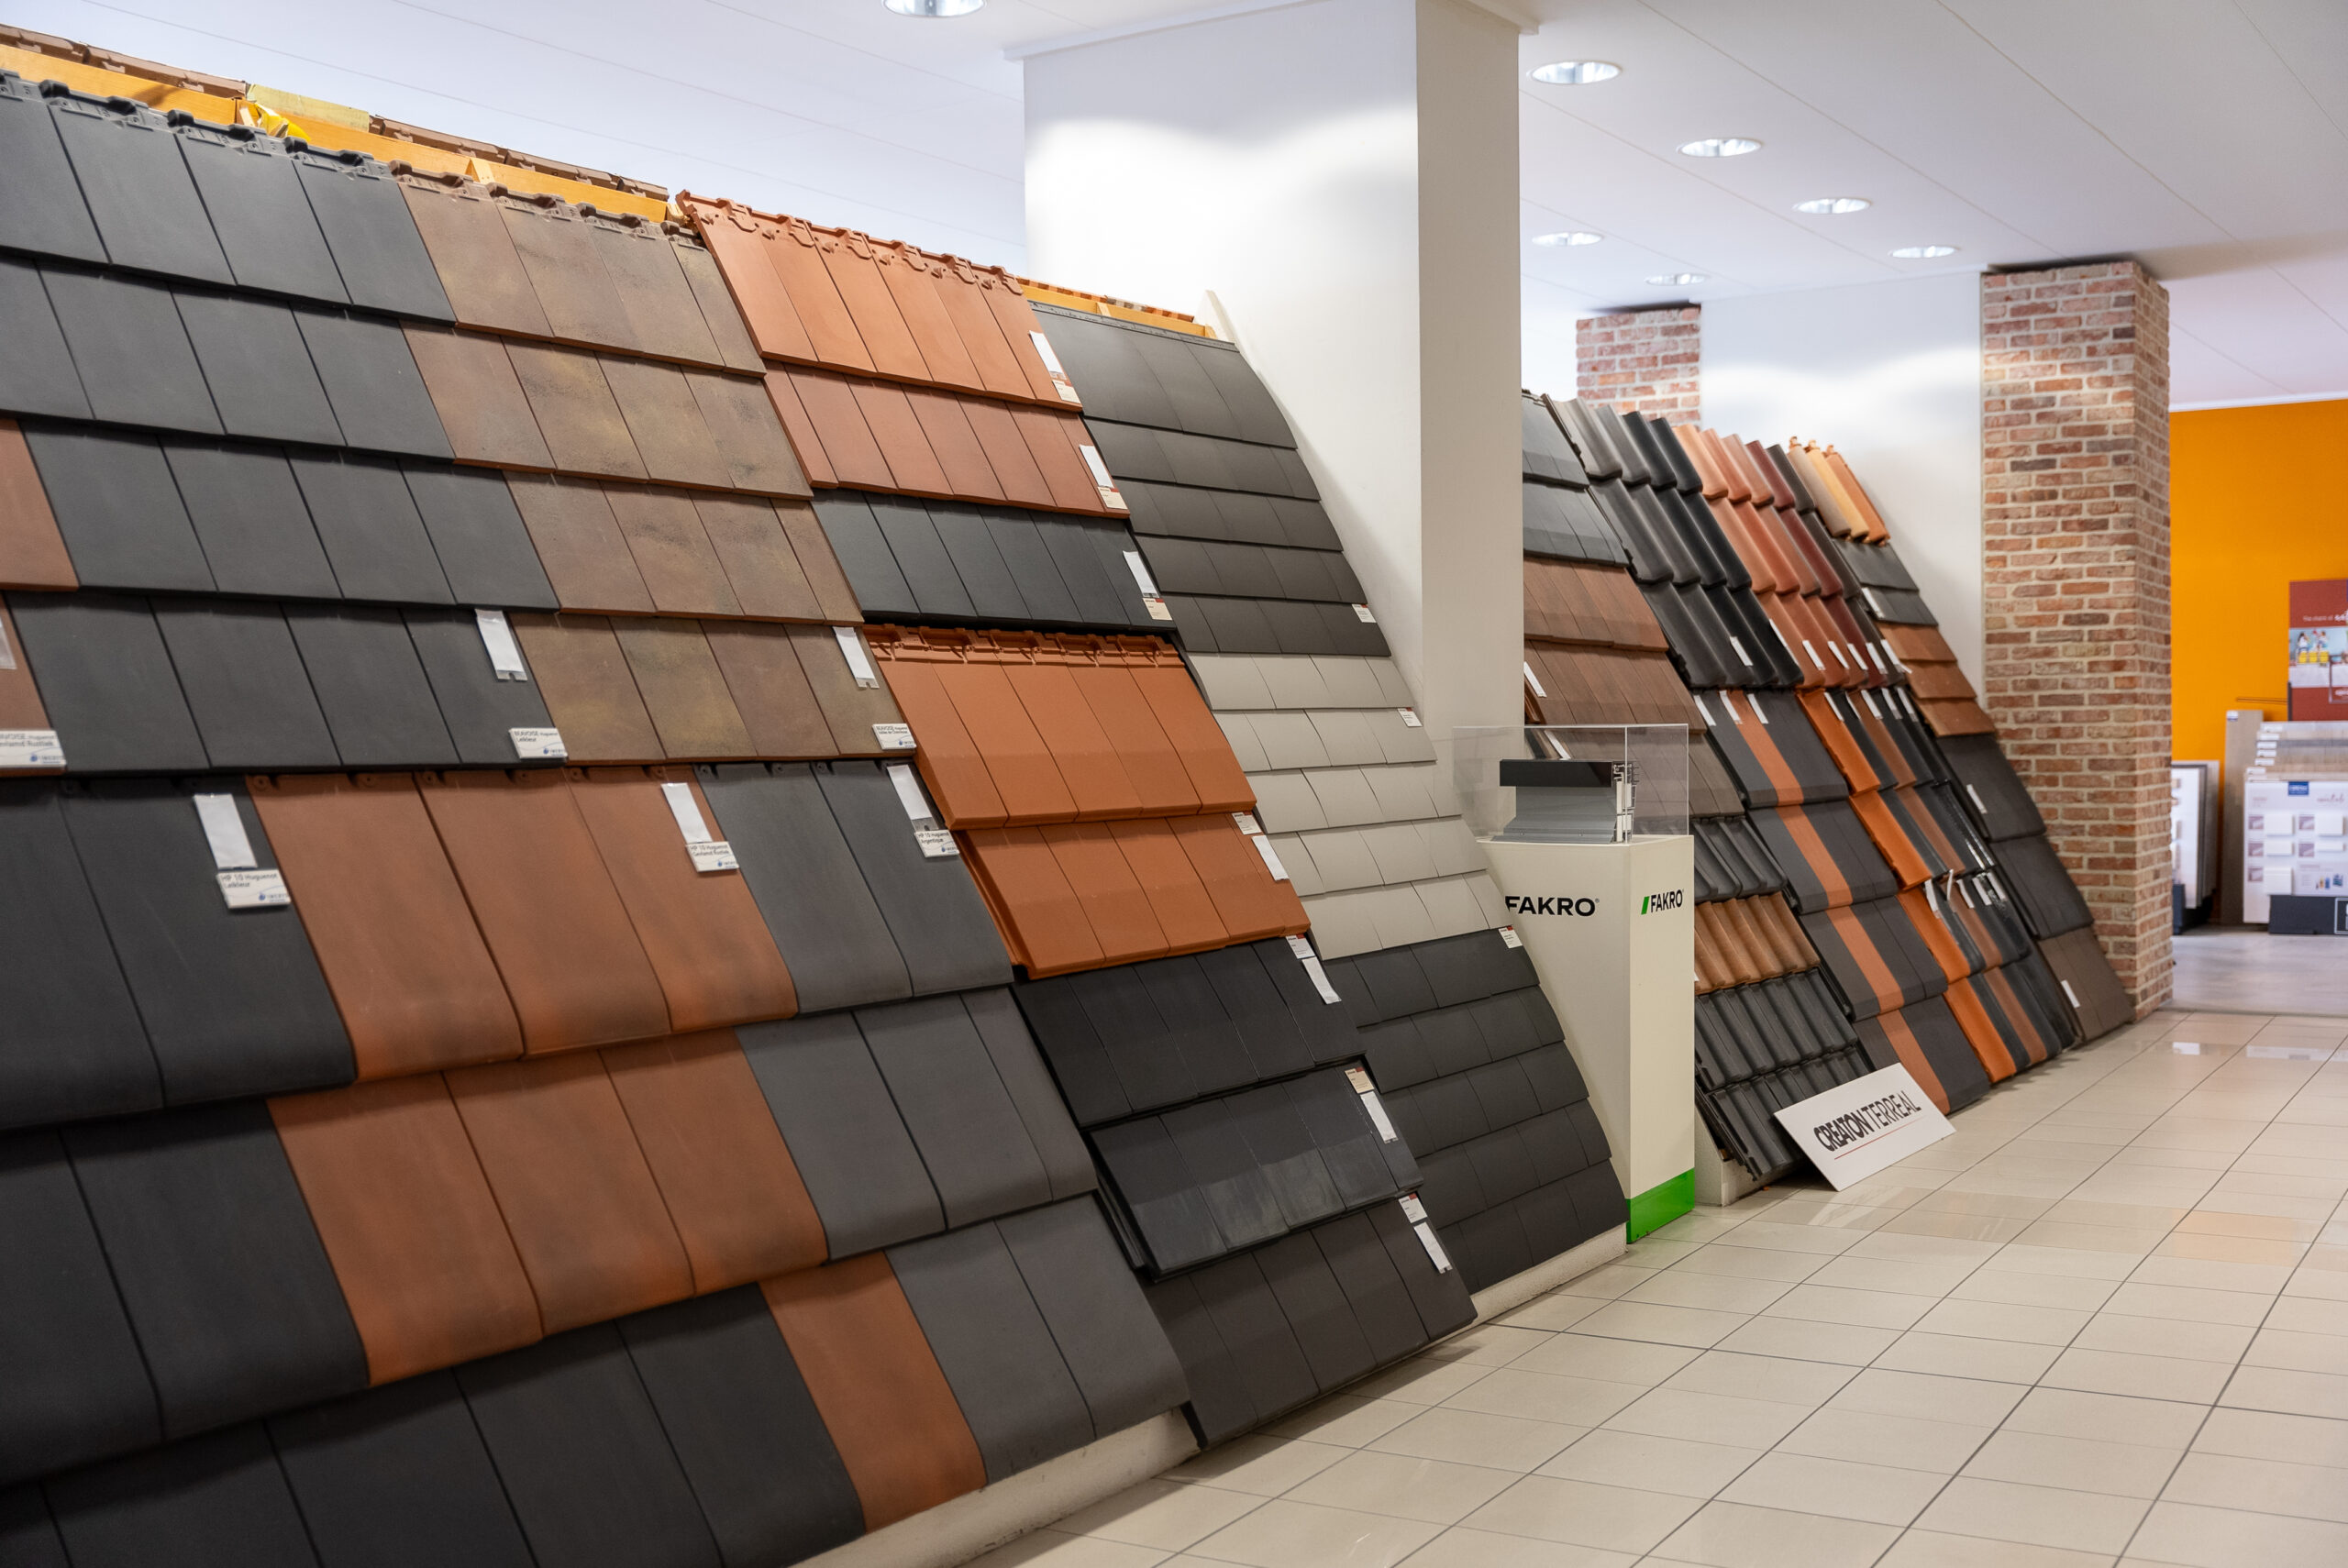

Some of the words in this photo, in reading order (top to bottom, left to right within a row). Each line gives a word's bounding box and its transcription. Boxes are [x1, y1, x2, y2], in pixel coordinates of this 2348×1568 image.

[1505, 896, 1596, 917] FAKRO
[1650, 889, 1683, 913] FAKRO
[1813, 1109, 1875, 1152] CREATON
[1860, 1089, 1922, 1130] TERREAL
